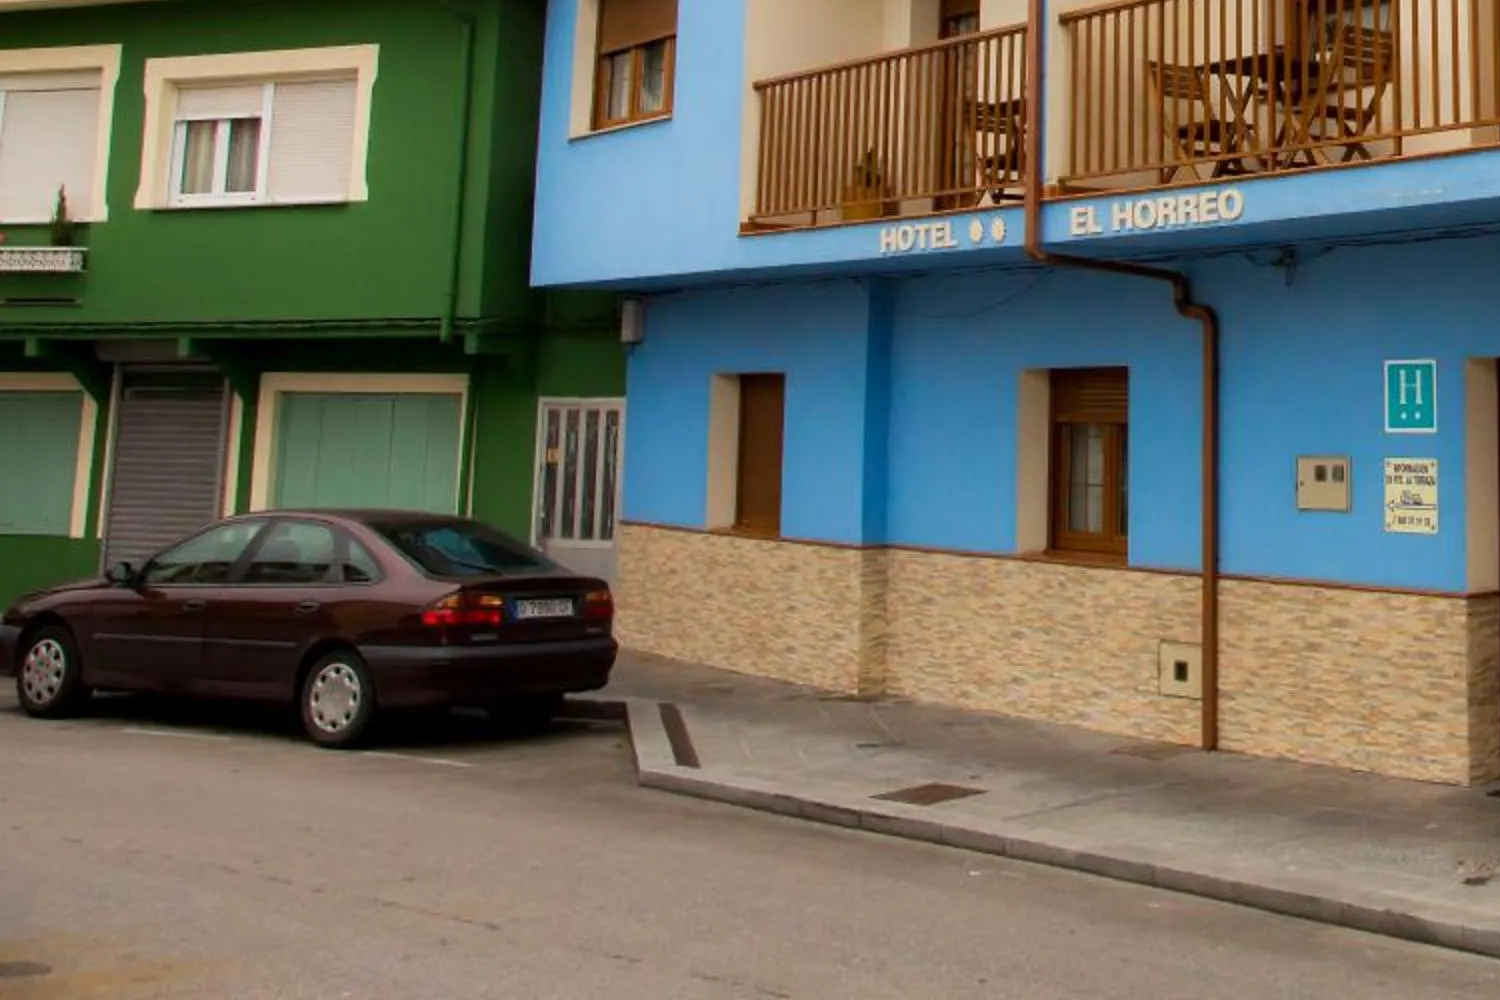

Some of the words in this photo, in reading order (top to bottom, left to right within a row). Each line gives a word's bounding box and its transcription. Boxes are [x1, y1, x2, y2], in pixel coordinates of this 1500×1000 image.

[1070, 205, 1103, 236] EL
[1112, 187, 1244, 232] HORREO
[879, 221, 958, 253] HOTEL
[1399, 369, 1424, 405] H
